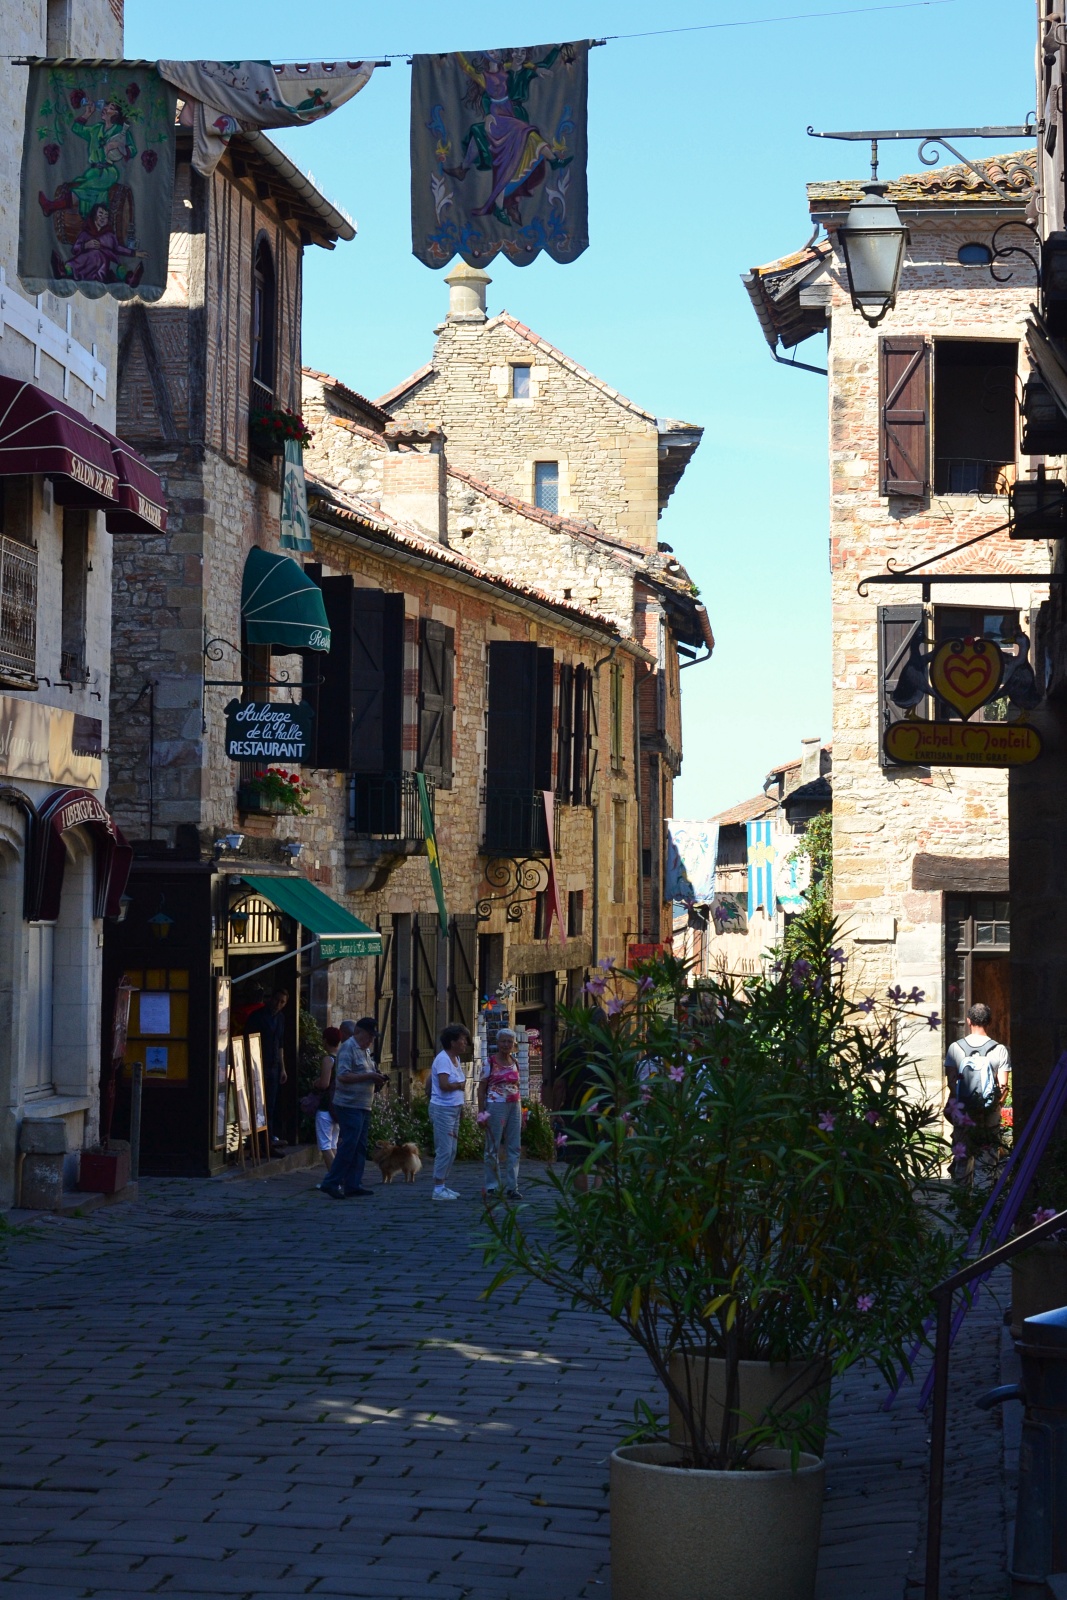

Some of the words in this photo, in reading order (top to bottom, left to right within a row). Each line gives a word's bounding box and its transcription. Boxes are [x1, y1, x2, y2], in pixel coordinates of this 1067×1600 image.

[70, 456, 94, 487] SALON
[94, 470, 104, 491] DE
[235, 702, 292, 730] Auberge
[246, 723, 260, 739] de
[262, 724, 272, 739] la
[274, 723, 303, 741] halle
[891, 726, 954, 750] Michel
[961, 726, 1031, 752] Monteil
[229, 740, 306, 758] RESTAURANT
[914, 752, 953, 760] L'ARTISAN
[966, 752, 983, 761] FOIE
[985, 753, 1008, 762] GRAS
